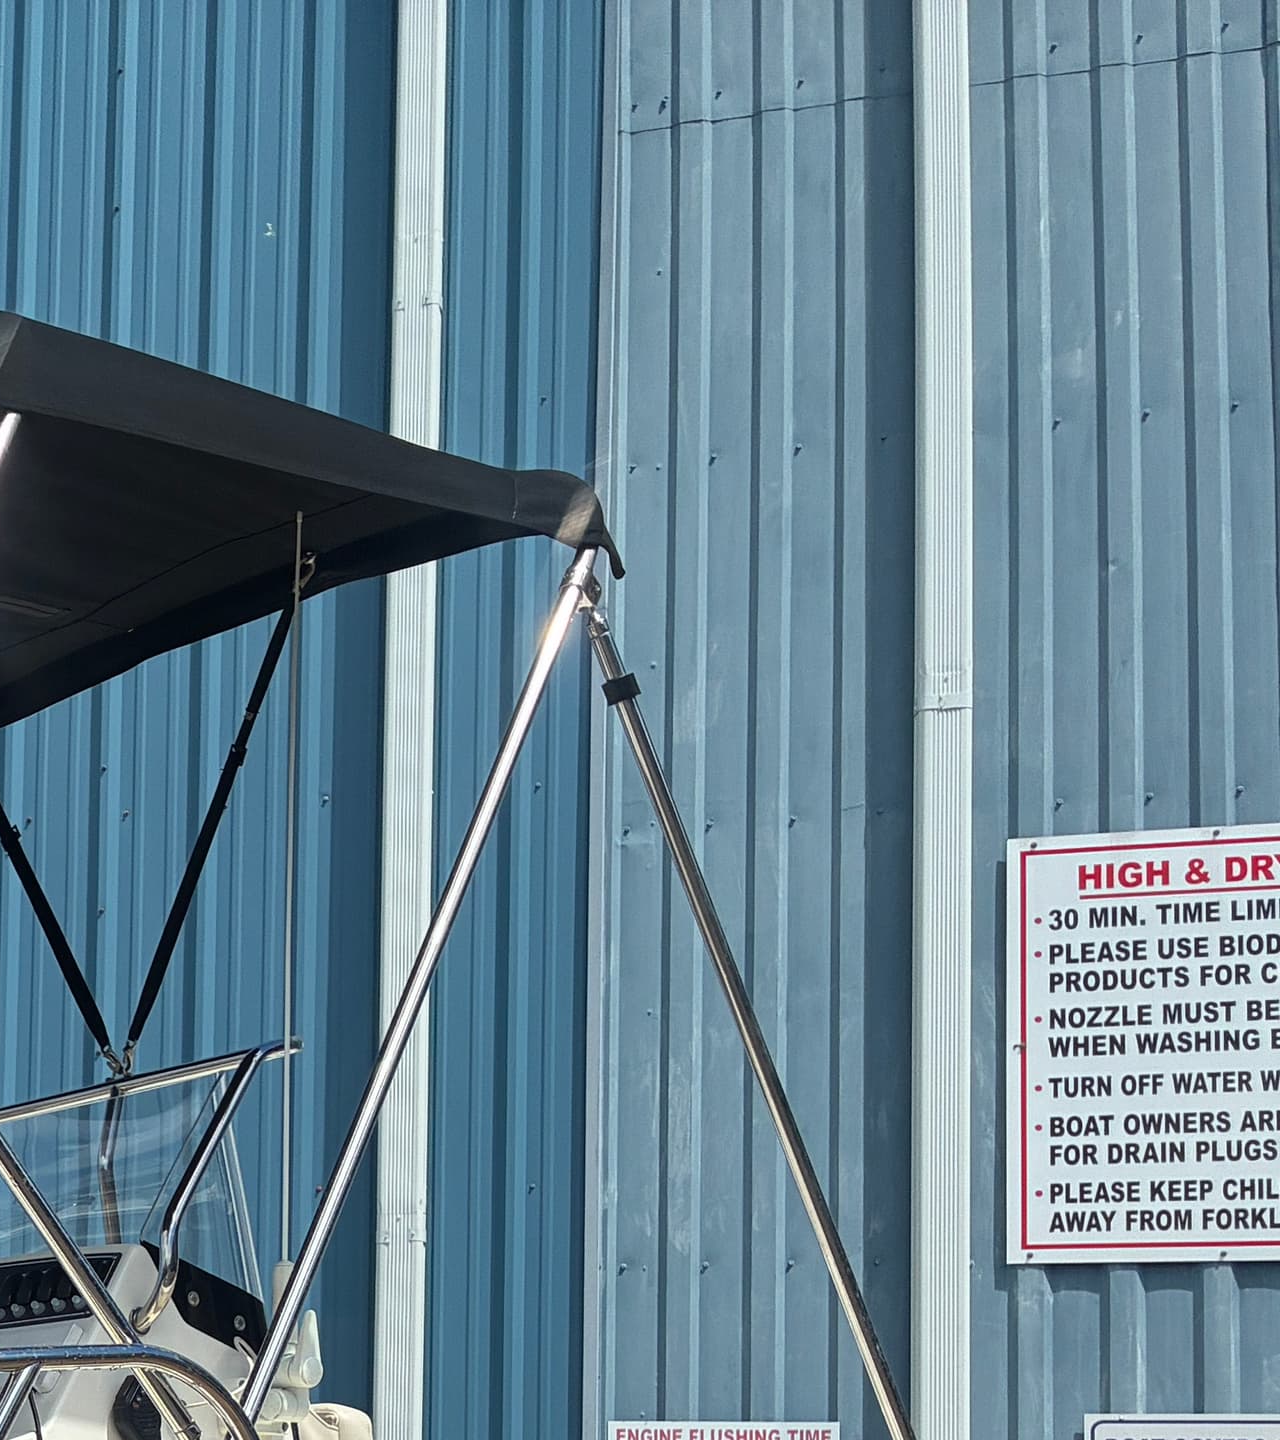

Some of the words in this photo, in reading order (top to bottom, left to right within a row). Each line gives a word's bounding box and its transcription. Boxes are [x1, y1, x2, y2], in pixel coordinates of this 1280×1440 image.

[1078, 860, 1170, 891] HIGH
[1185, 857, 1210, 885] &
[1049, 909, 1079, 930] 30
[1089, 905, 1146, 929] MIN.
[1156, 902, 1220, 926] TIME
[1231, 898, 1280, 921] LIM
[1049, 940, 1148, 965] PLEASE
[1157, 936, 1209, 960] USE
[1219, 934, 1280, 956] BIOD
[1049, 967, 1190, 993] PRODUCTS
[1200, 963, 1252, 987] FOR
[1049, 1005, 1152, 1030] NOZZLE
[1162, 1001, 1237, 1025] MUST
[1247, 999, 1280, 1021] BE
[1049, 1033, 1127, 1058] WHEN
[1136, 1029, 1261, 1055] WASHING
[1049, 1075, 1112, 1099] TURN
[1121, 1073, 1164, 1097] OFF
[1171, 1070, 1253, 1094] WATER
[1049, 1114, 1114, 1138] BOAT
[1123, 1111, 1231, 1135] OWNERS
[1049, 1143, 1098, 1166] FOR
[1107, 1141, 1186, 1164] DRAIN
[1196, 1139, 1278, 1163] PLUGS
[1049, 1181, 1141, 1204] PLEASE
[1150, 1179, 1214, 1202] KEEP
[1222, 1178, 1280, 1201] CHIL
[1049, 1210, 1116, 1233] AWAY
[1125, 1208, 1193, 1232] FROM
[1202, 1207, 1280, 1231] FORKL
